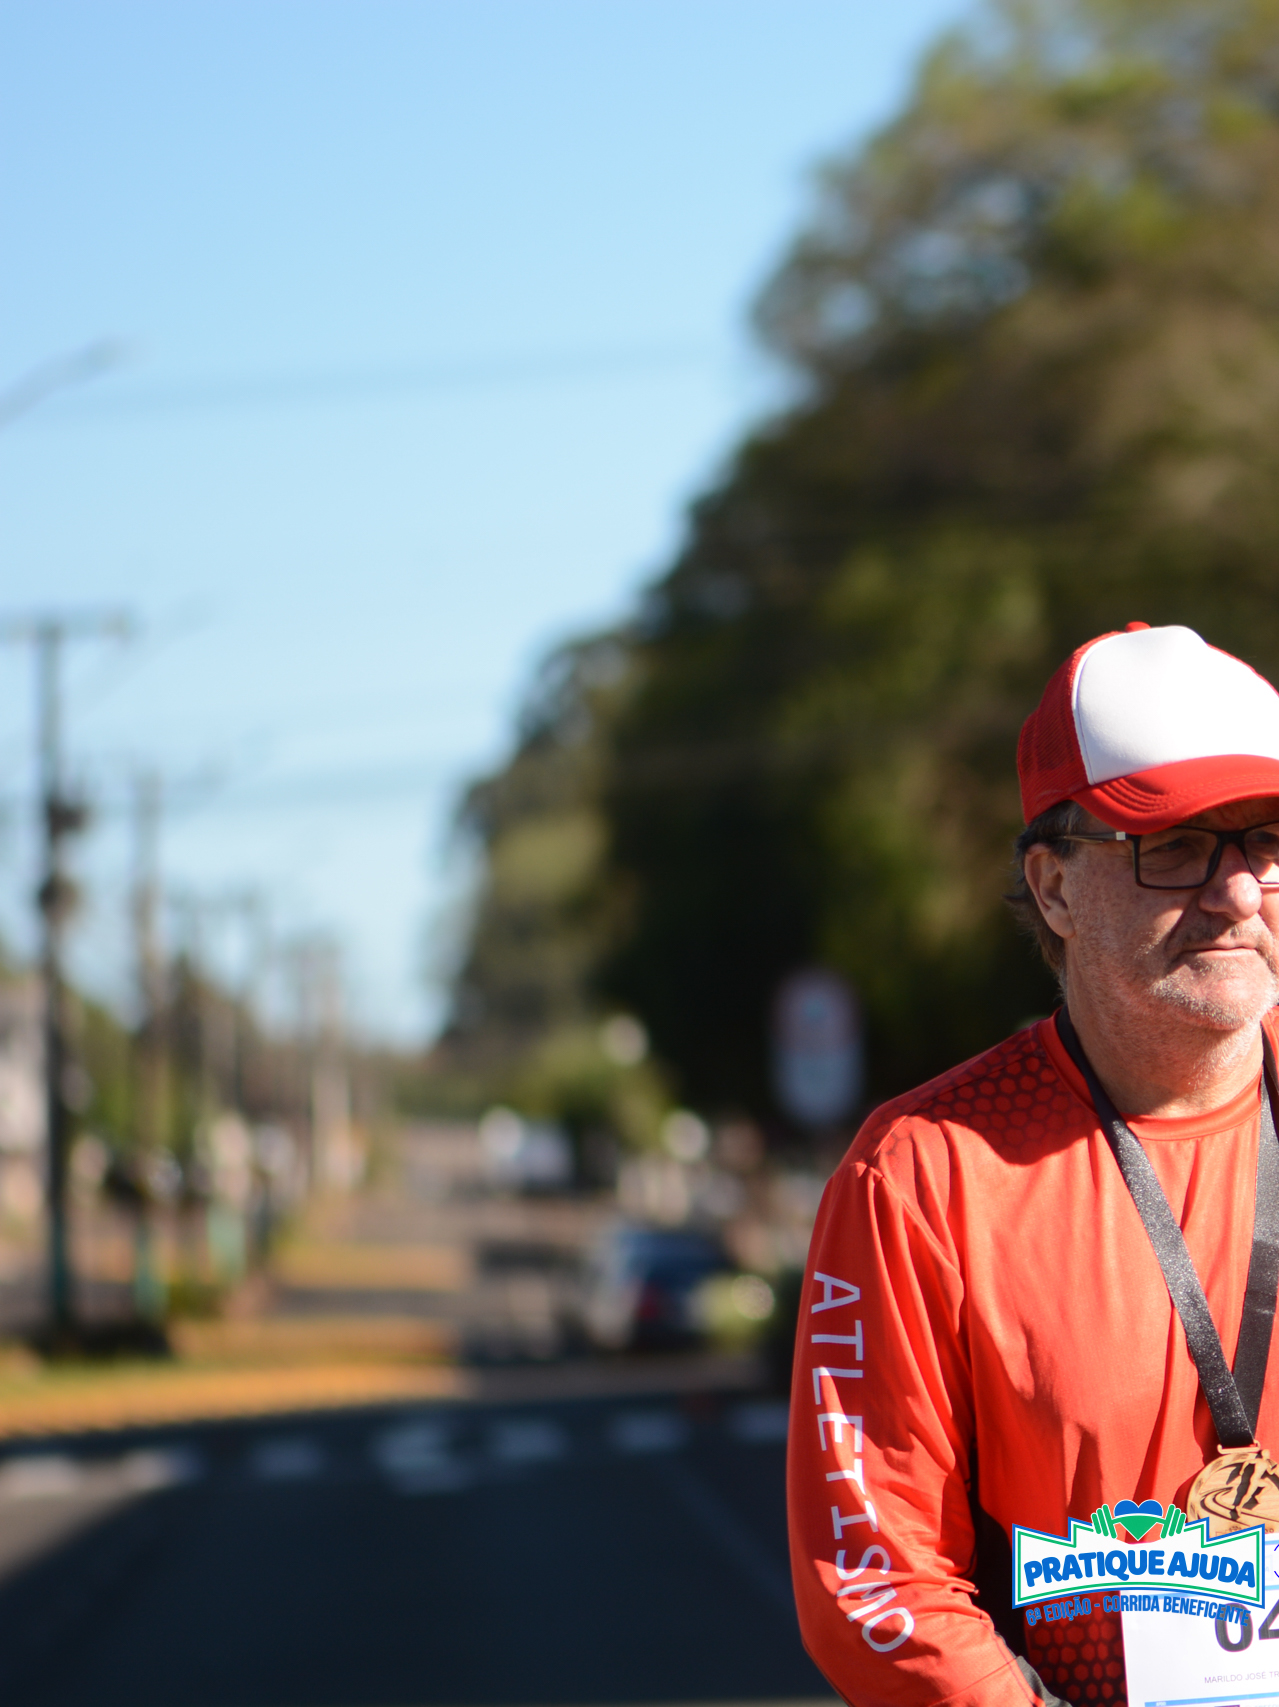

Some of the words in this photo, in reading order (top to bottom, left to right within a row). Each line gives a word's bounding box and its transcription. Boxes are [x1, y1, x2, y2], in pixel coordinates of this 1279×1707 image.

[811, 1271, 915, 1653] ATLETISMO
[1204, 1673, 1243, 1684] MARILDO
[1245, 1671, 1267, 1681] JOSÉ
